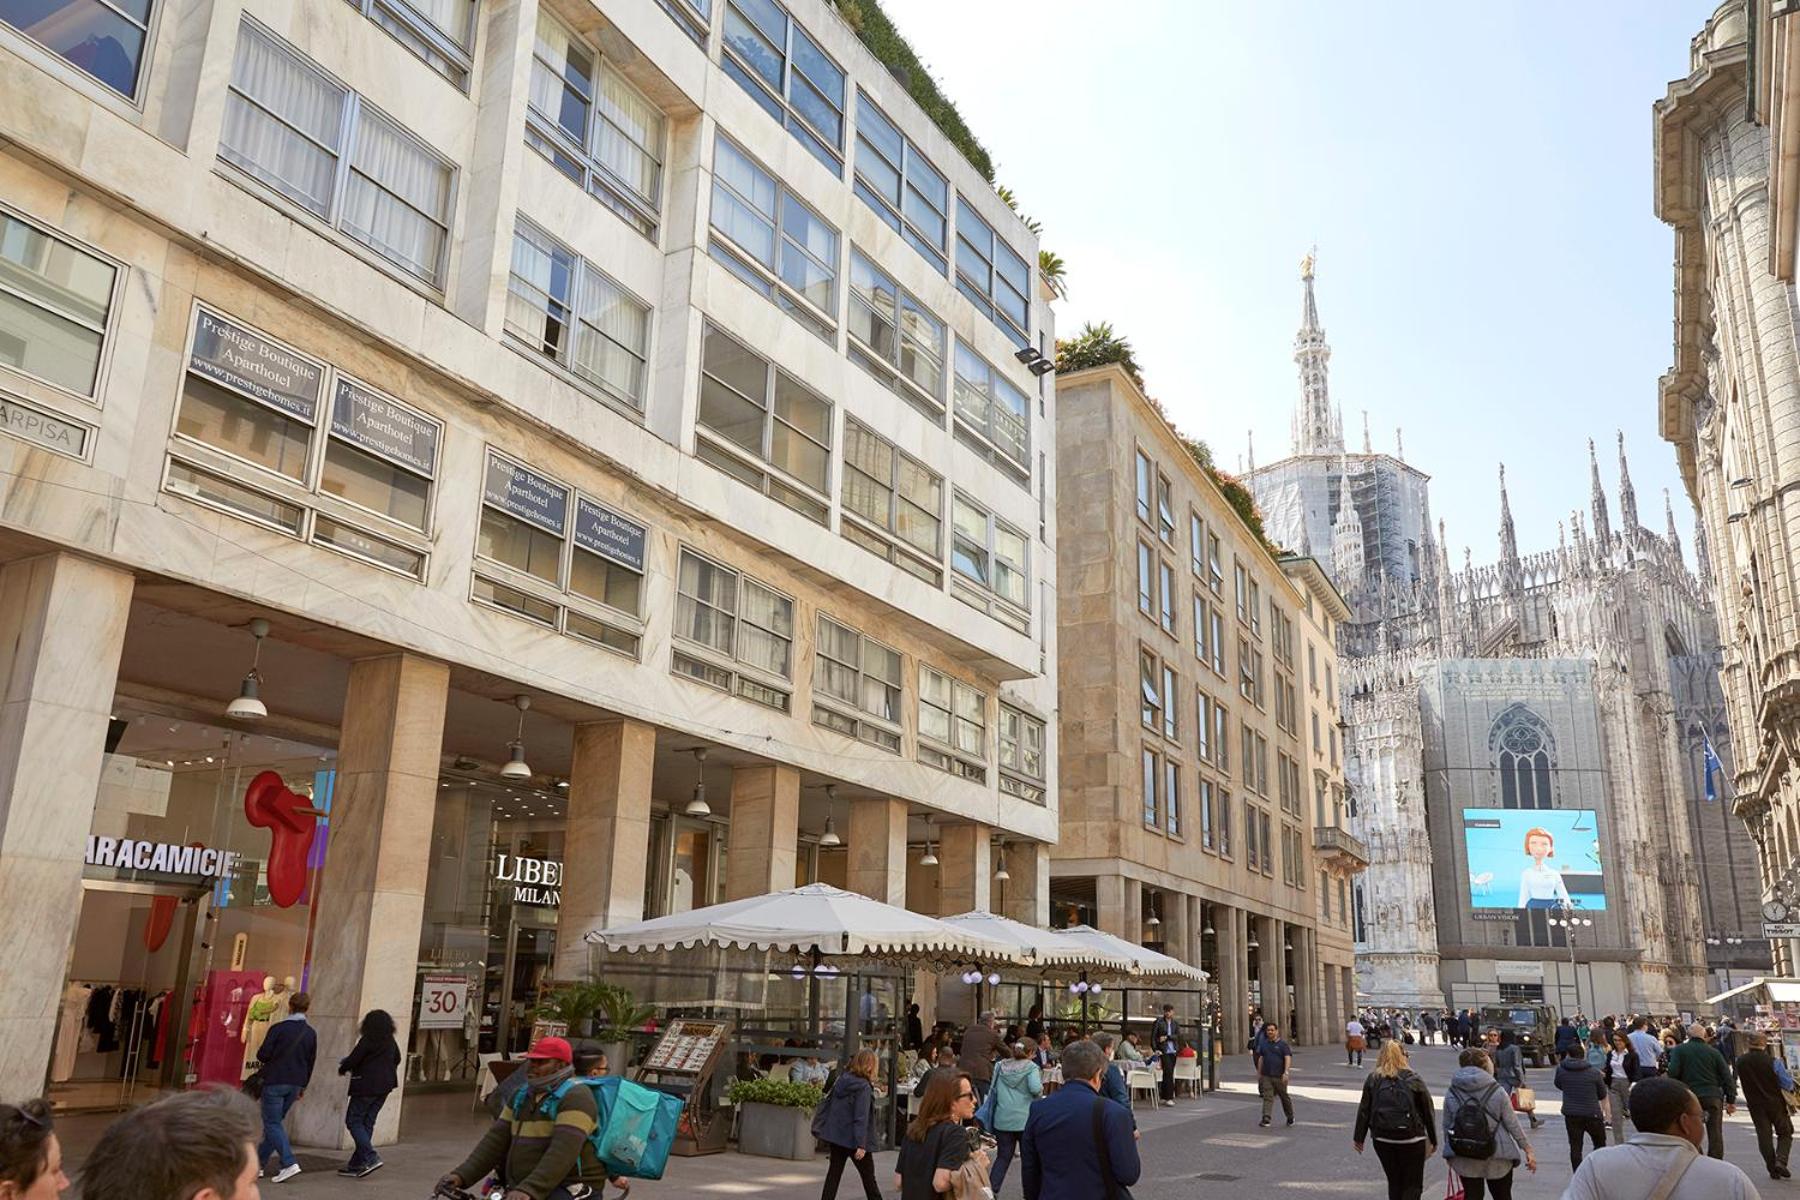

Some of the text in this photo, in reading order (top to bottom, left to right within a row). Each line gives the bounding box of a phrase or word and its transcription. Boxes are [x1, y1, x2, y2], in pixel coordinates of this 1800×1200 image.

[202, 317, 315, 380] Prestige Boutique
[223, 348, 290, 388] Aparthotel
[193, 357, 311, 417] www.prestigehomes.it
[340, 383, 433, 437] Prestige Boutique
[356, 412, 413, 445] Aparthotel
[333, 421, 430, 470] www.prestigehomes.it
[491, 456, 564, 500] Prestige Boutique
[504, 480, 549, 508] Aparthotel
[486, 489, 562, 531] www.prestigehomes.it
[579, 501, 642, 538] Prestige Boutique
[591, 522, 630, 546] Aparthotel
[496, 853, 564, 887] LIBE
